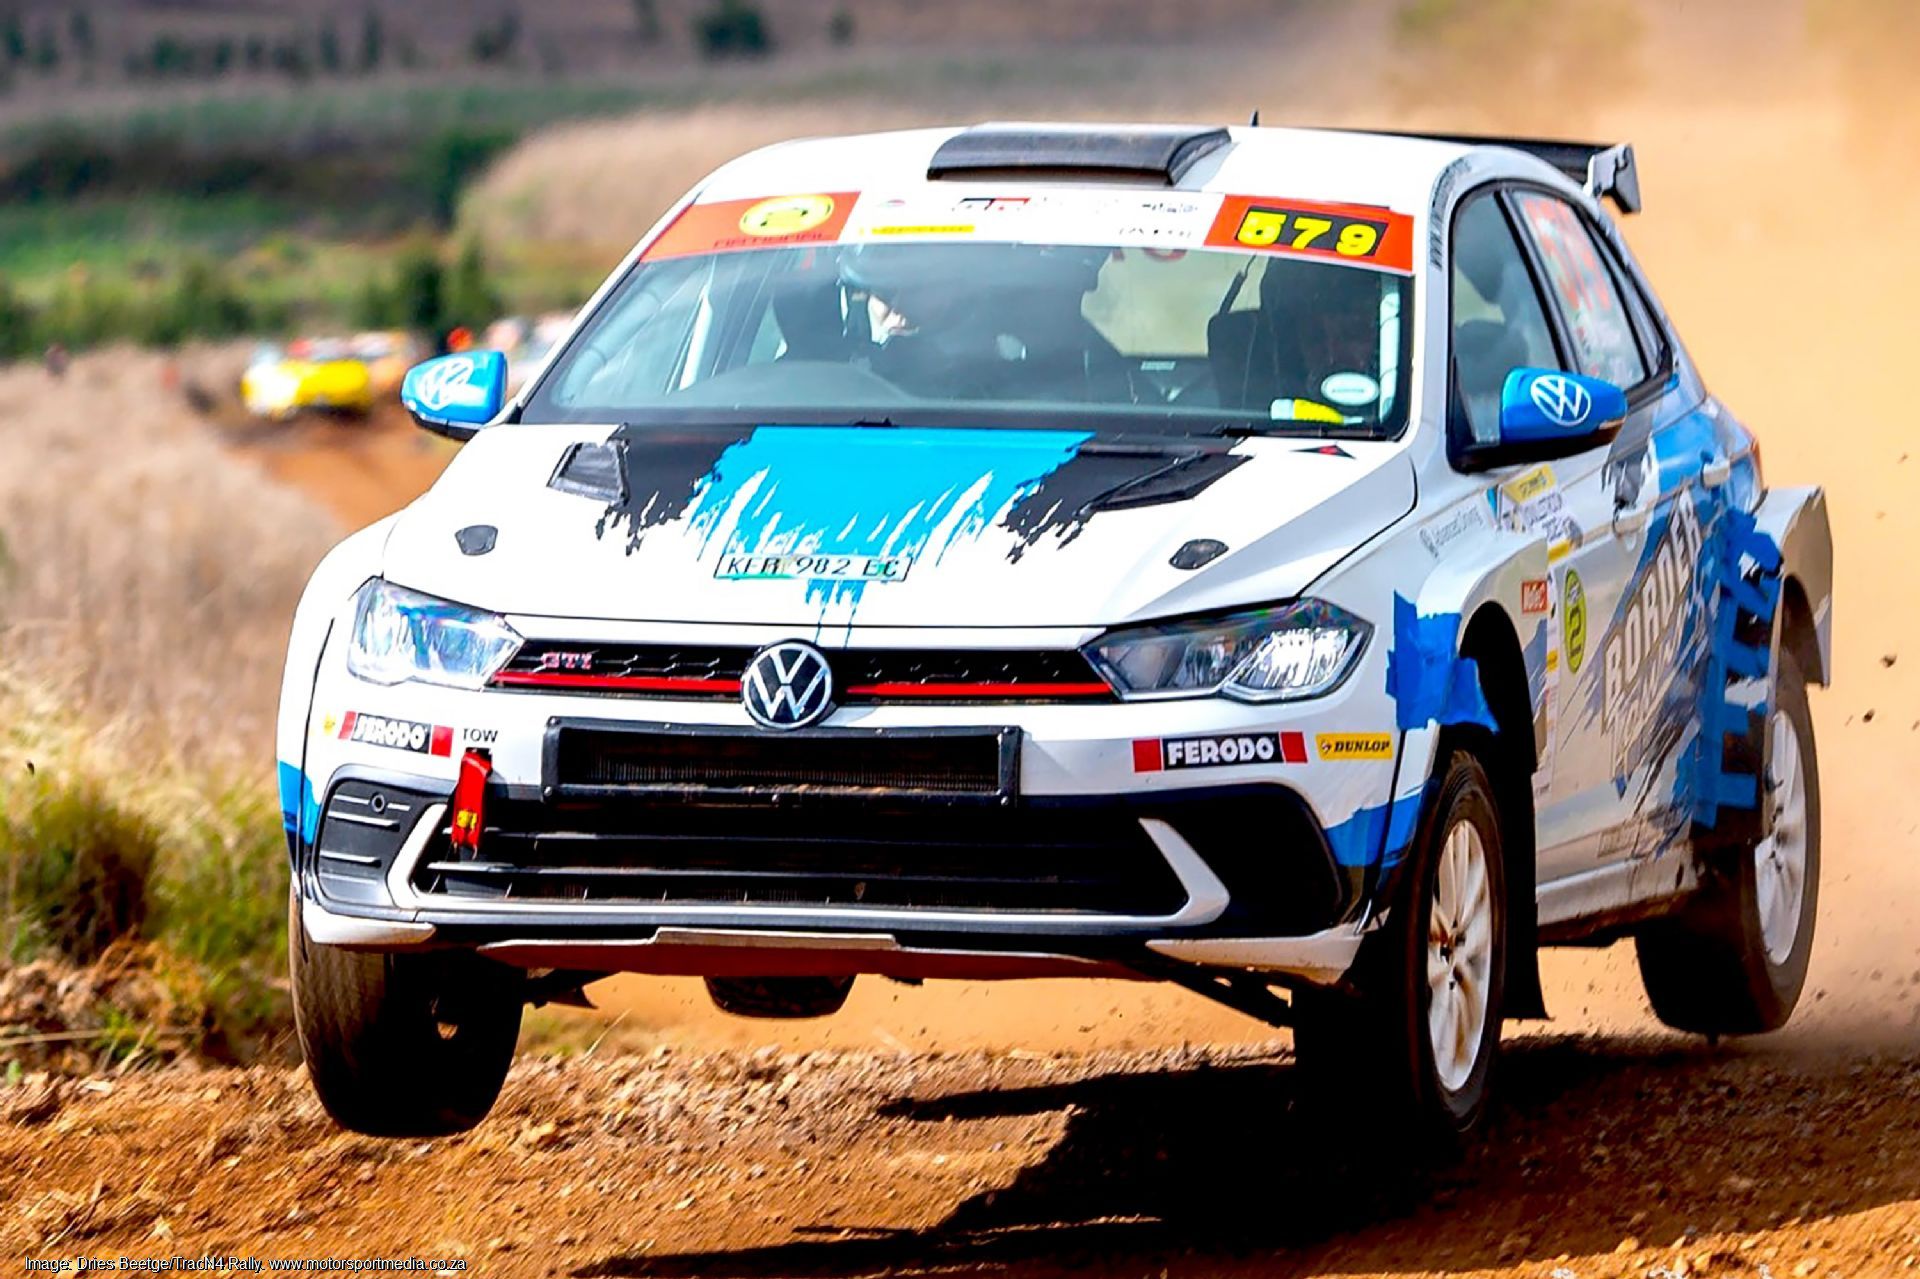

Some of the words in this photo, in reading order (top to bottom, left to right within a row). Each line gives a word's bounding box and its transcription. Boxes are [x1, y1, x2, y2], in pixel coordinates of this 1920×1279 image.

[1237, 211, 1377, 256] 579
[796, 557, 850, 575] 982
[1603, 490, 1701, 725] BORDER
[1166, 737, 1274, 765] FERODO
[1333, 740, 1390, 753] DUNLOP
